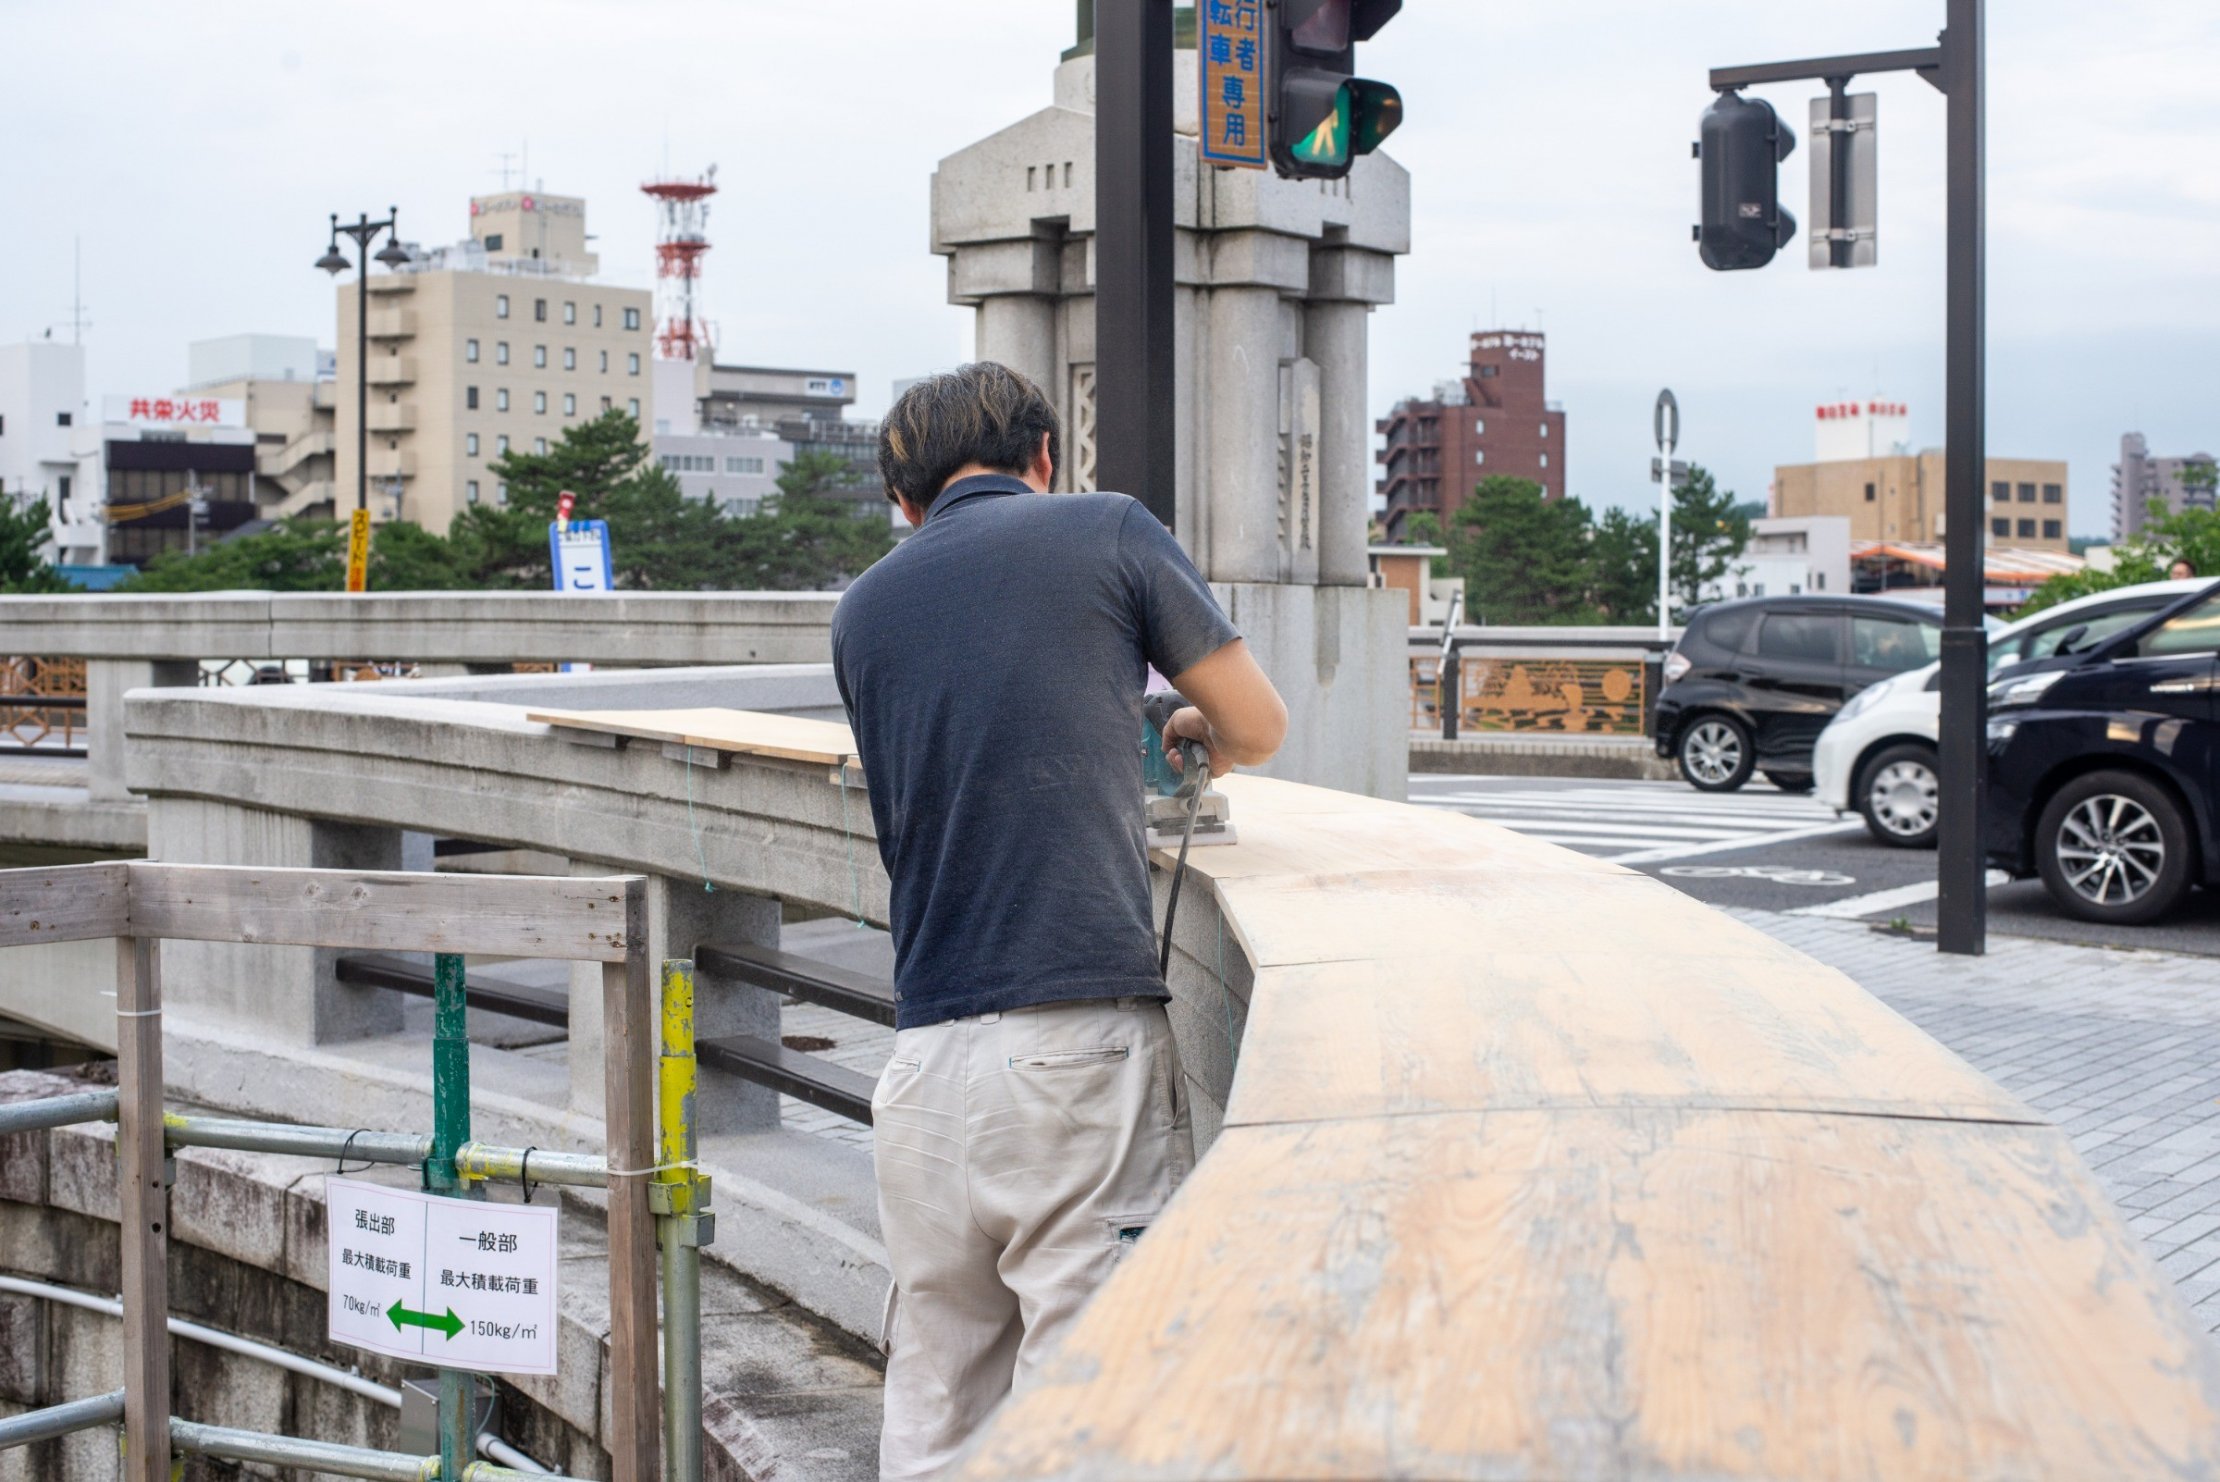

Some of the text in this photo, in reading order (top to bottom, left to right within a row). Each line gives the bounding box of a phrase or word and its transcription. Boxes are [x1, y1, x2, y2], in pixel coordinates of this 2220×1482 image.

[1235, 0, 1256, 71] 行者
[1222, 75, 1245, 146] 専用
[129, 398, 220, 422] 共栄火災
[355, 1209, 395, 1236] 張出部
[459, 1231, 518, 1253] 一般部
[342, 1248, 411, 1280] 最大積載荷重
[440, 1269, 538, 1295] 最大積載荷重
